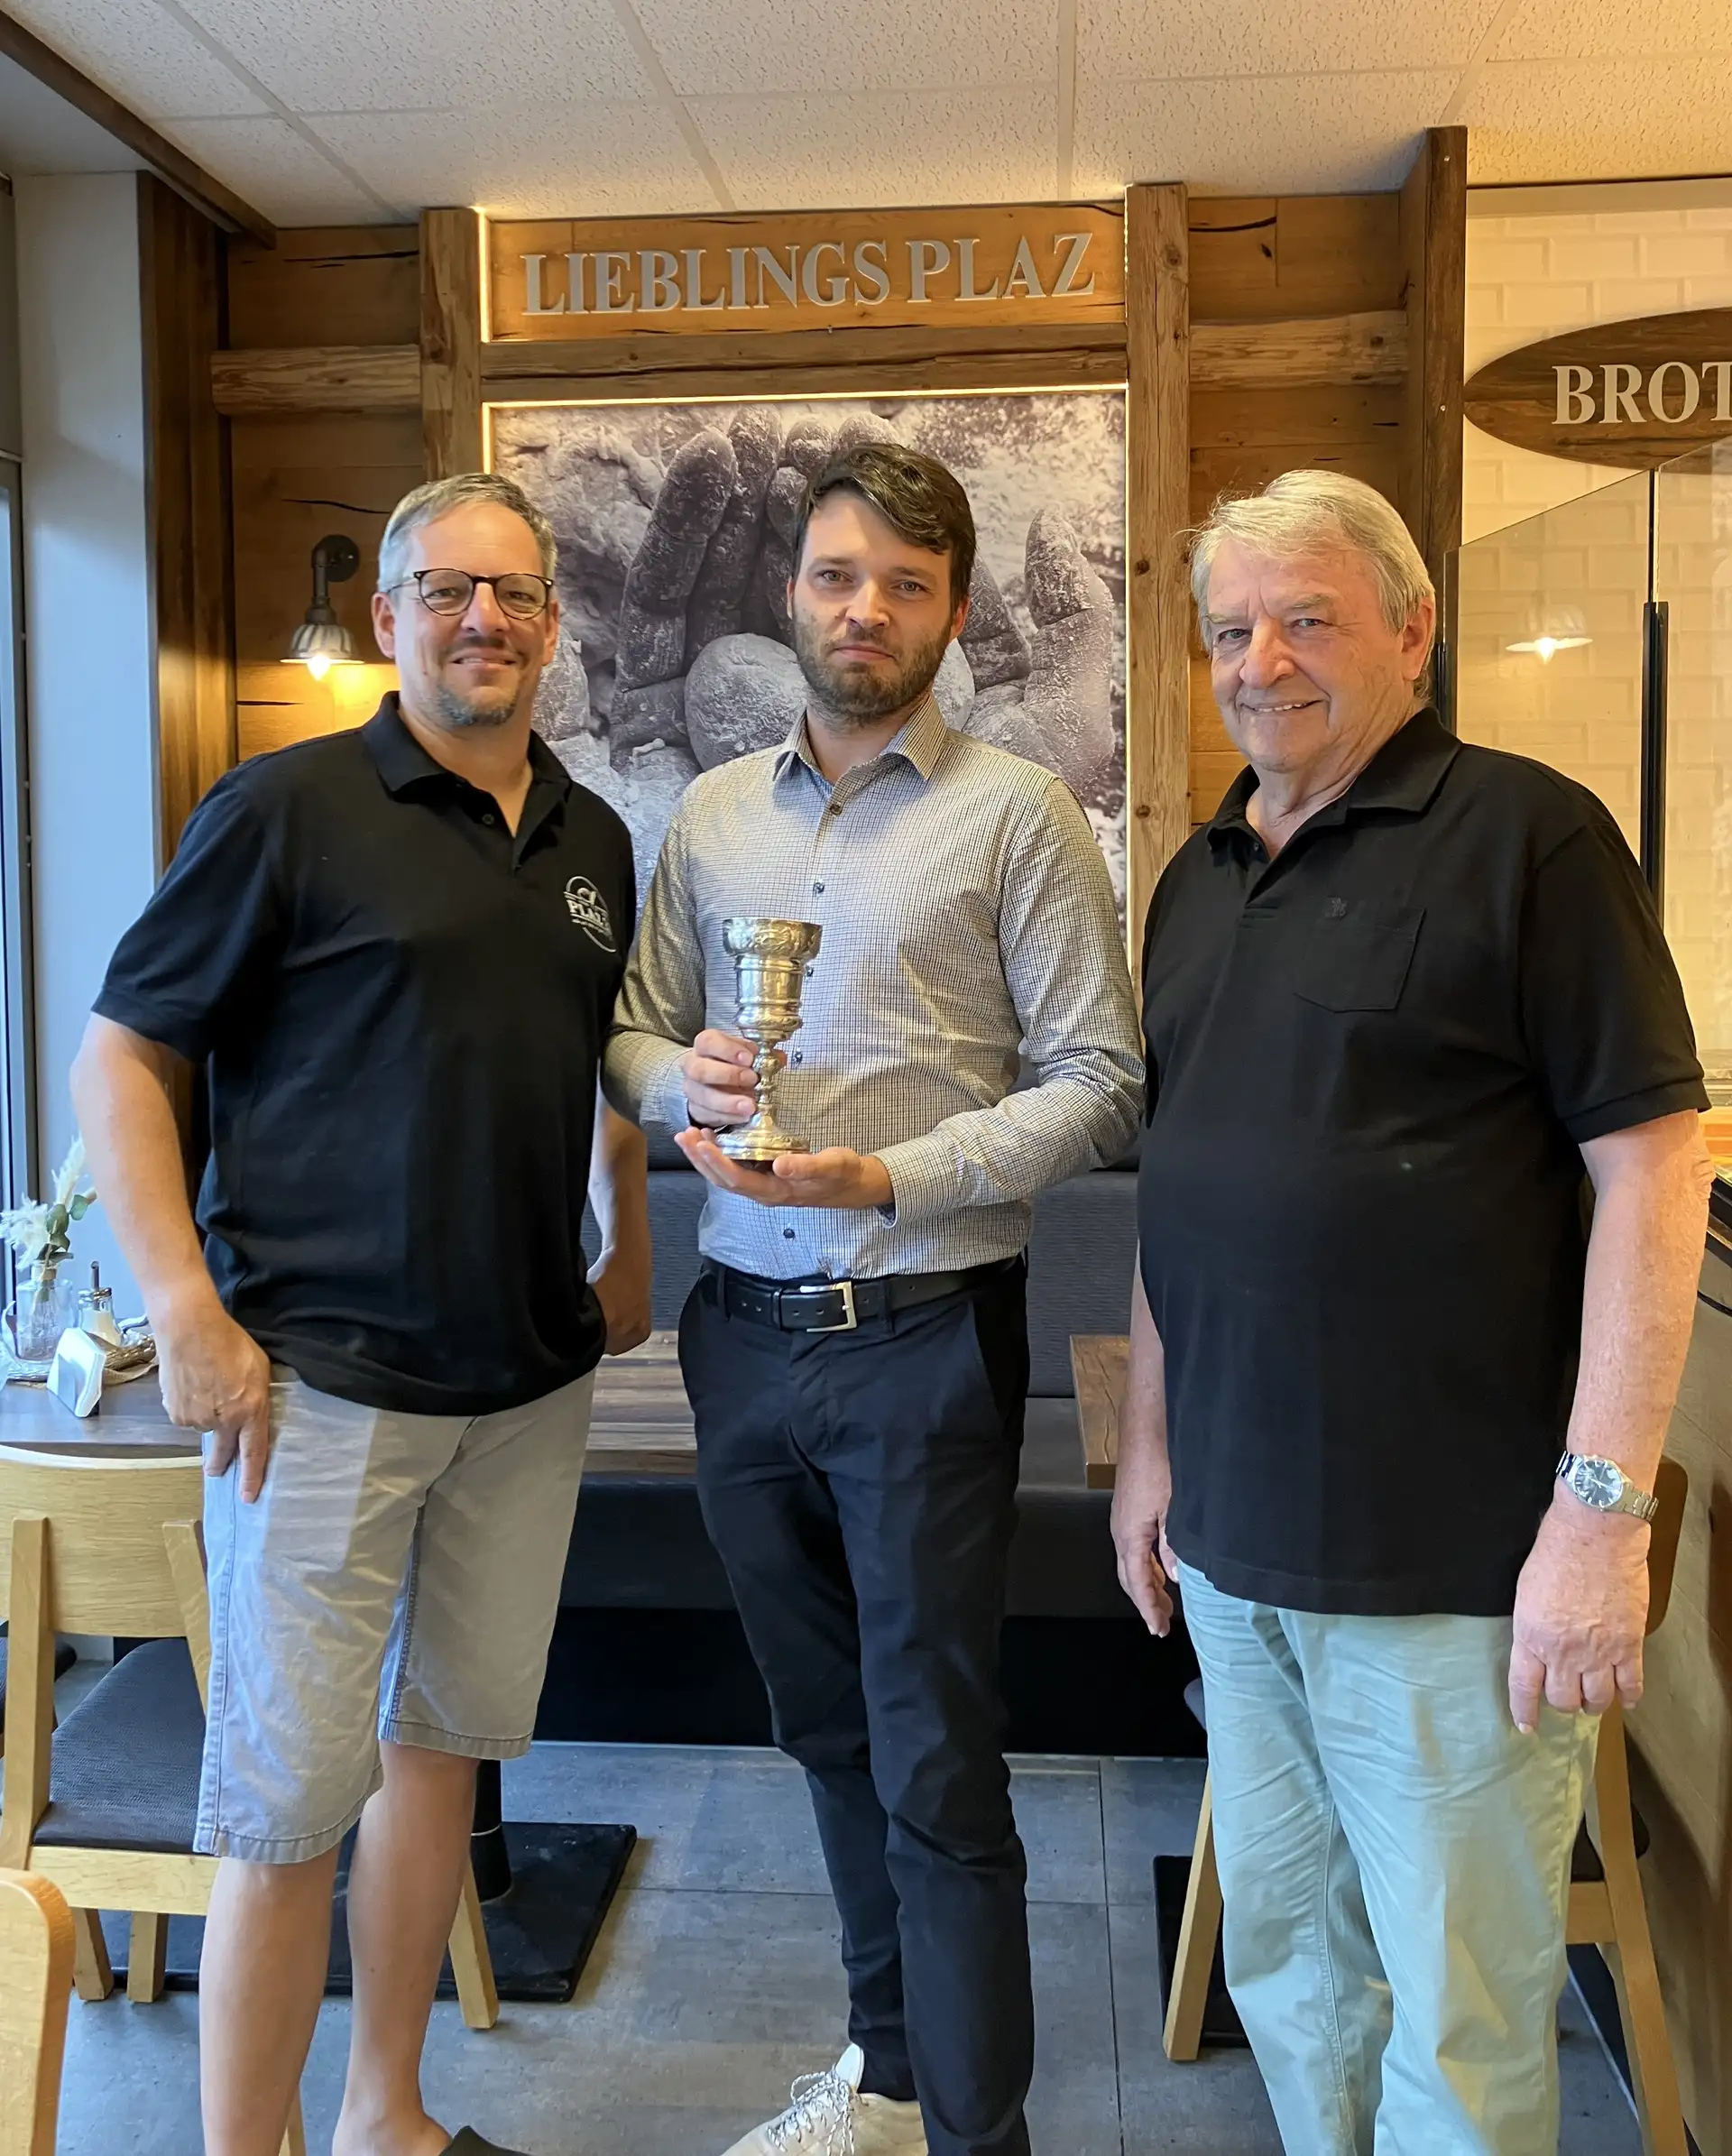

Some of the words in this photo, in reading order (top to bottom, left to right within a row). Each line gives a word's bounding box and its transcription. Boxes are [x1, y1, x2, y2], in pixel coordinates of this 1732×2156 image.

[521, 240, 891, 316] LIEBLINGS
[905, 232, 1094, 304] PLAZ
[1551, 361, 1732, 425] BROT
